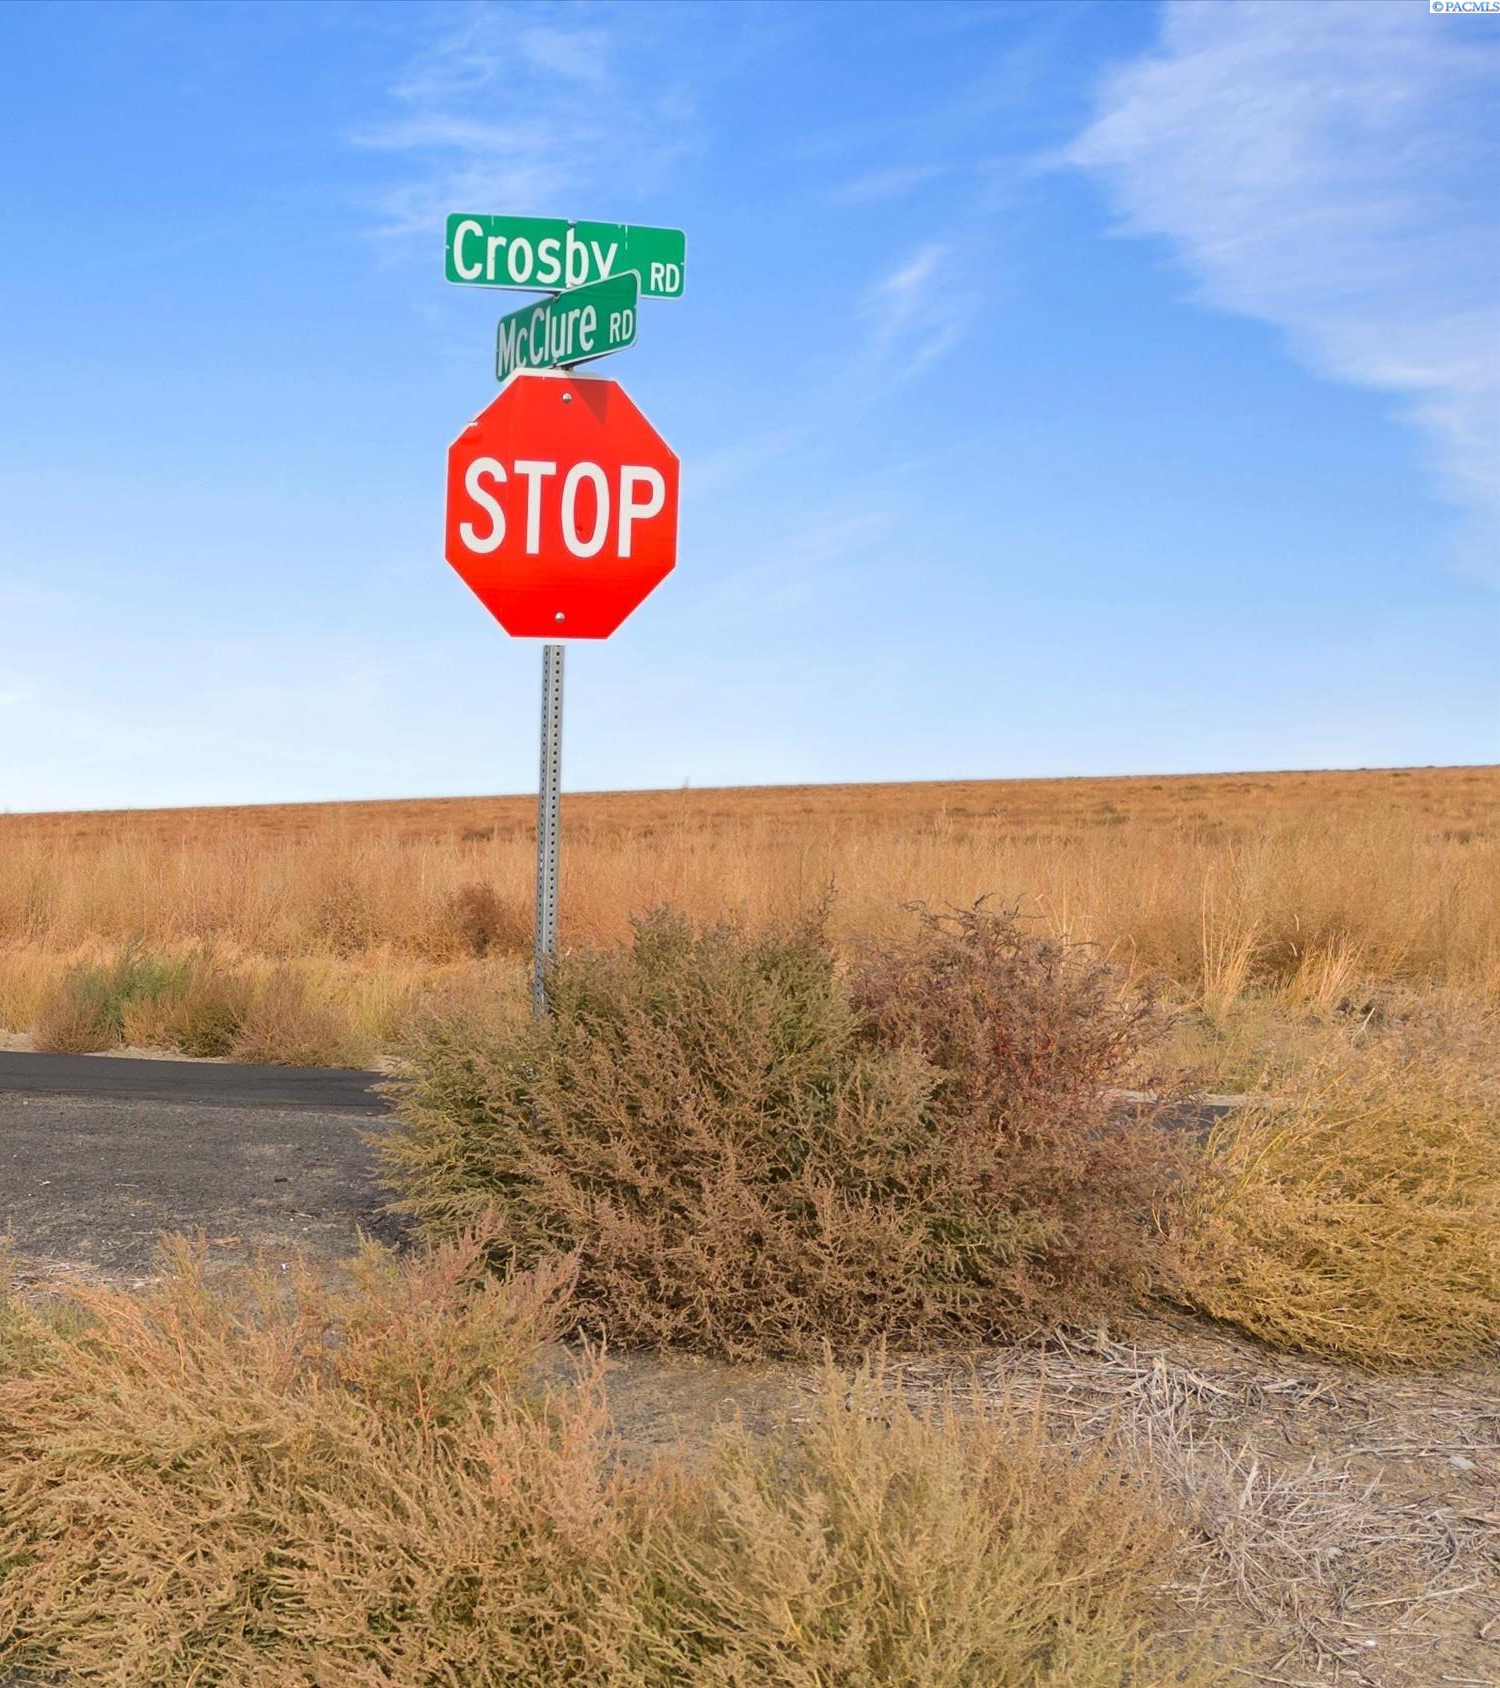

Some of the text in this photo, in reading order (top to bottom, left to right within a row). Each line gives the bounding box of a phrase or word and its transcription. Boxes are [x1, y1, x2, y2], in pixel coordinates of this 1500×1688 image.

[453, 219, 681, 293] Crosby RD
[498, 305, 633, 377] McClure RD
[459, 456, 666, 558] STOP
